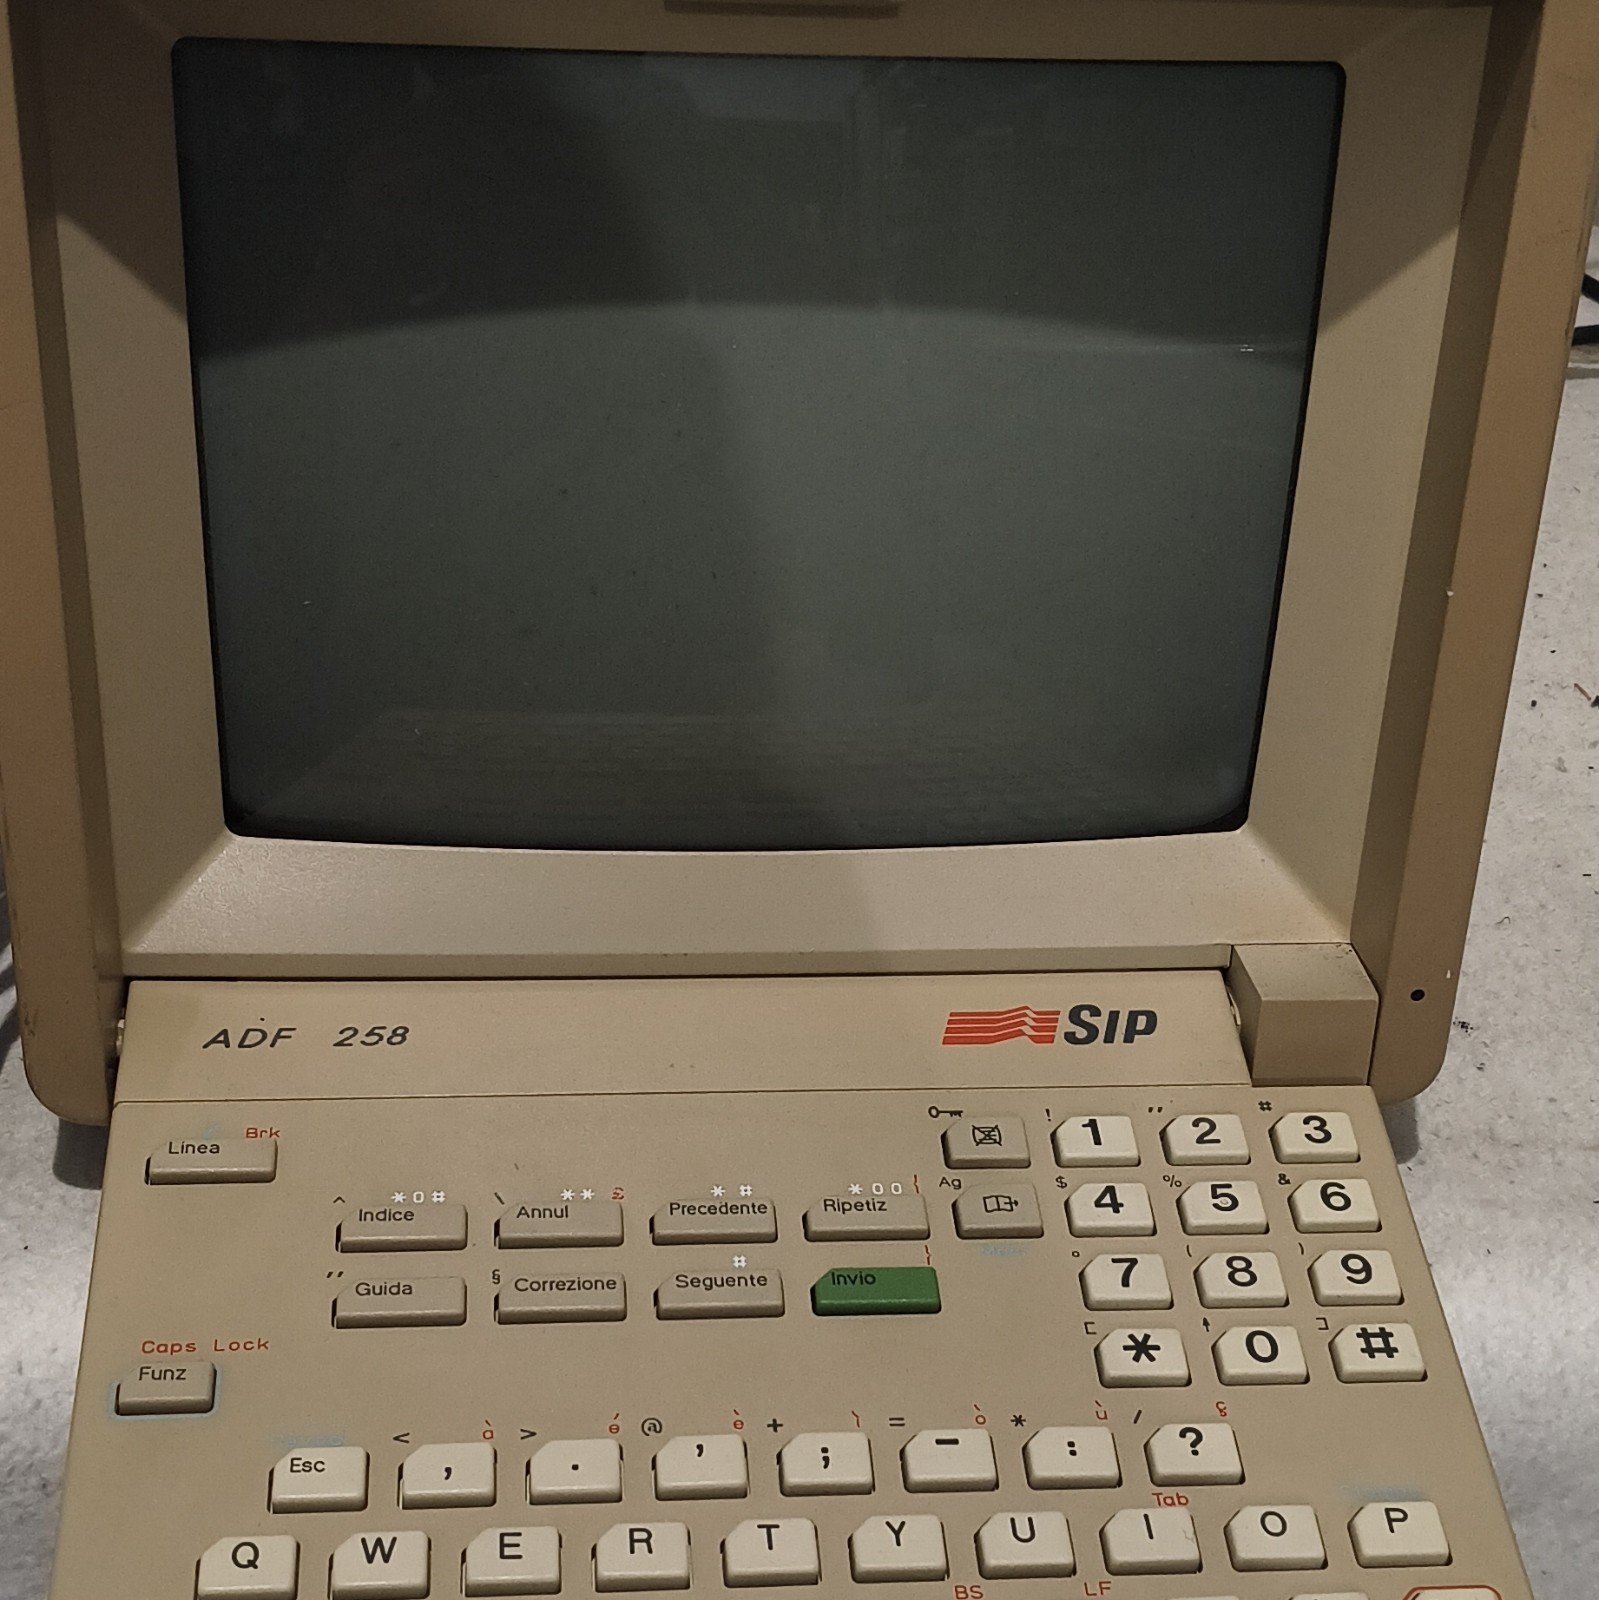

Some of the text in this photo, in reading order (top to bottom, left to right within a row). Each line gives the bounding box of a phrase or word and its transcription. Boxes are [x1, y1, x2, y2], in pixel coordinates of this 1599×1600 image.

[200, 1024, 411, 1050] ADF 258
[244, 1126, 281, 1140] Brk
[1079, 1117, 1104, 1147] 1
[1190, 1117, 1222, 1145] 2
[1302, 1114, 1333, 1145] 3
[167, 1140, 221, 1156] Linea
[938, 1176, 962, 1190] Ag
[668, 1200, 769, 1217] Precedente
[823, 1198, 888, 1214] Ripetiz
[1091, 1183, 1125, 1215] 4
[1208, 1183, 1240, 1213] 5
[1318, 1181, 1353, 1213] 6
[357, 1206, 416, 1223] Indice
[515, 1203, 571, 1219] Annul
[674, 1273, 769, 1291] Seguente
[830, 1270, 877, 1288] Invio
[1110, 1255, 1140, 1288] 7
[1226, 1254, 1259, 1287] 8
[1339, 1252, 1374, 1285] 9
[354, 1281, 414, 1297] Guida
[513, 1274, 617, 1293] Correzione
[141, 1336, 271, 1355] Caps Lock
[138, 1365, 188, 1382] Funz
[1178, 1426, 1204, 1457] ?
[289, 1457, 326, 1474] Esc
[1151, 1492, 1190, 1508] Tab
[885, 1520, 907, 1547] Y
[1009, 1515, 1037, 1544] U
[1259, 1510, 1288, 1538] O
[1384, 1507, 1410, 1534] P
[359, 1535, 399, 1565] W
[498, 1531, 524, 1561] E
[627, 1527, 655, 1556] R
[756, 1523, 781, 1551] T
[229, 1540, 261, 1571] Q
[953, 1583, 985, 1600] BS
[1083, 1580, 1113, 1598] LF
